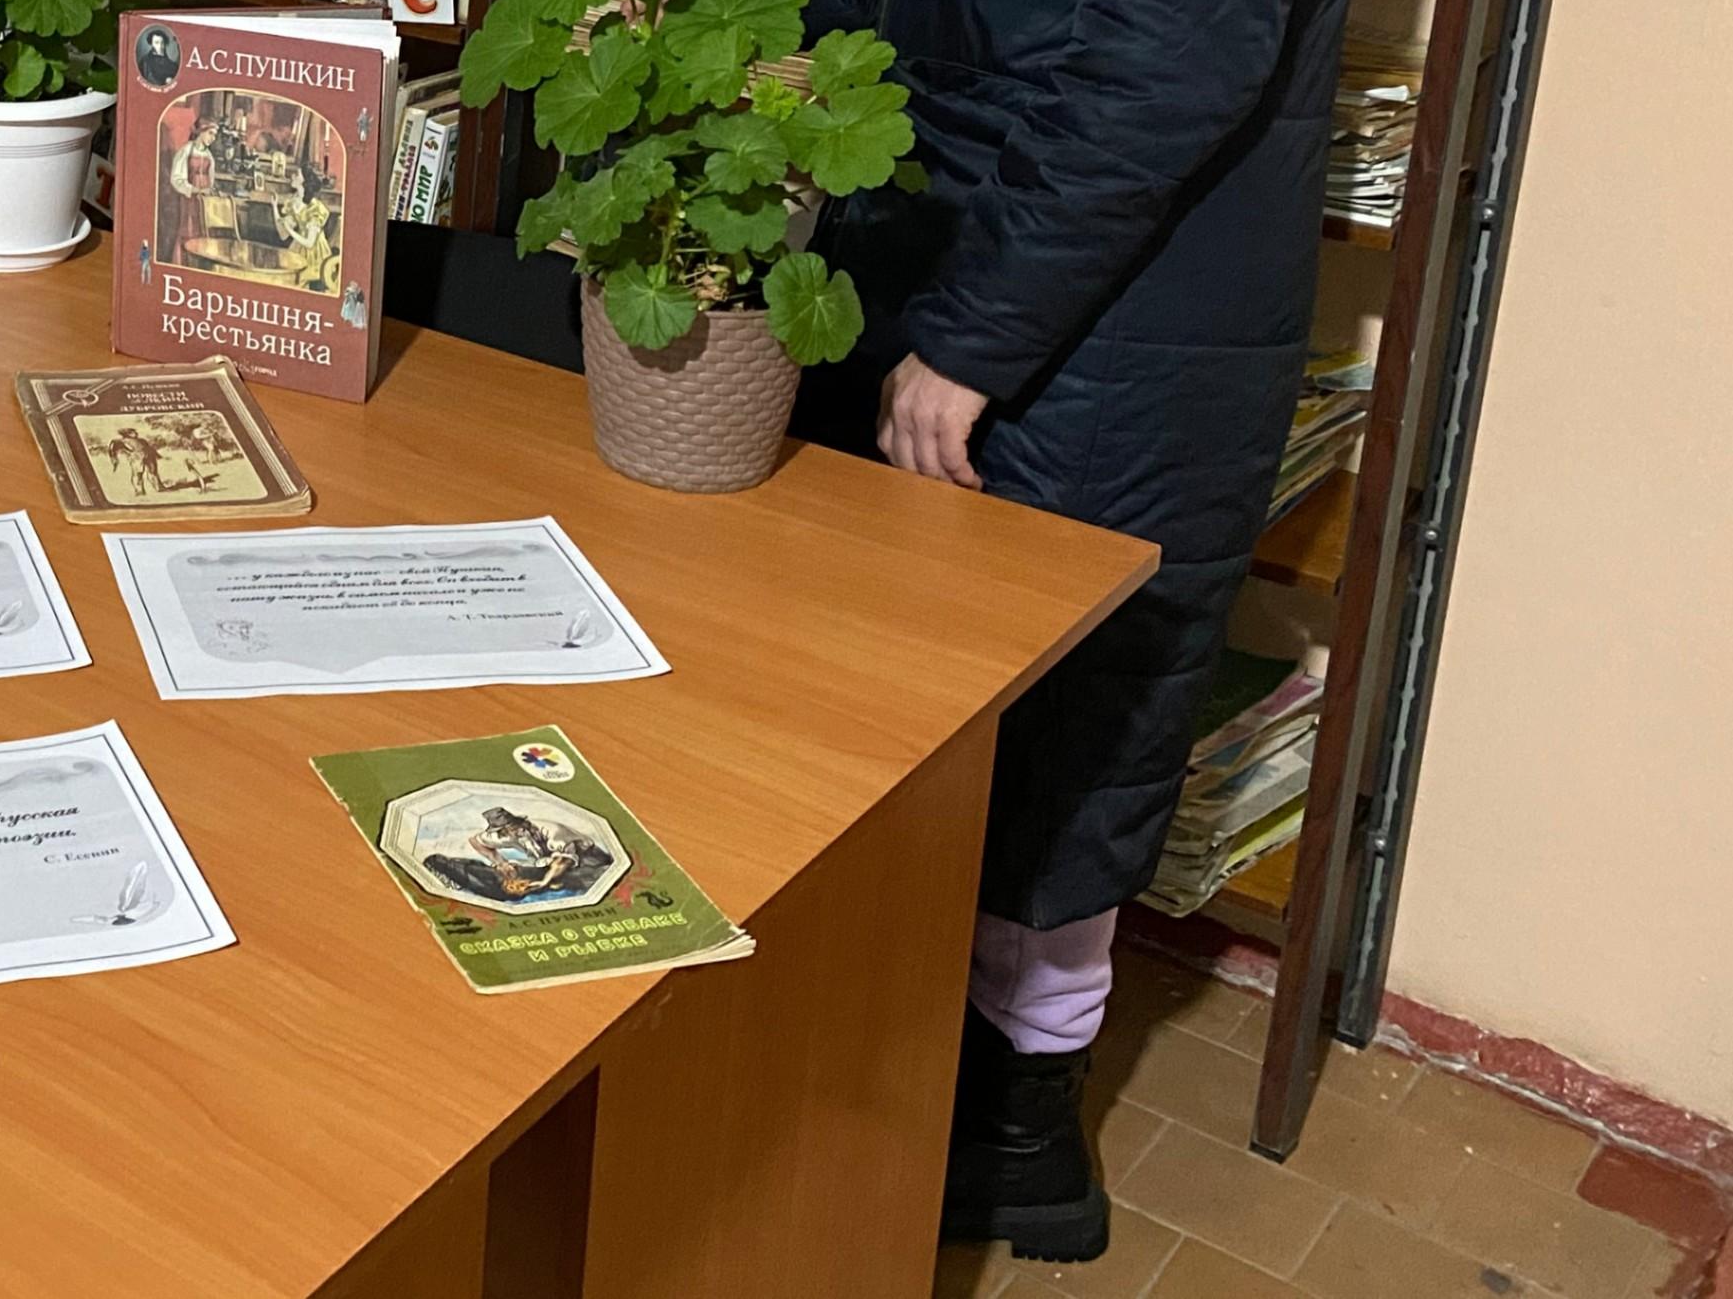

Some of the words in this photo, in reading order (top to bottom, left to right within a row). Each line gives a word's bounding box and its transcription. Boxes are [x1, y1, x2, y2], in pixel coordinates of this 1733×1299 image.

[162, 275, 334, 334] Барышня-
[162, 313, 332, 366] крестьянка
[66, 846, 120, 863] Есенин
[459, 932, 557, 955] СКАЗКА
[562, 927, 577, 941] О
[583, 912, 689, 936] РЫБАКЕ
[527, 949, 549, 962] И
[556, 934, 649, 957] РЫБКЕ
